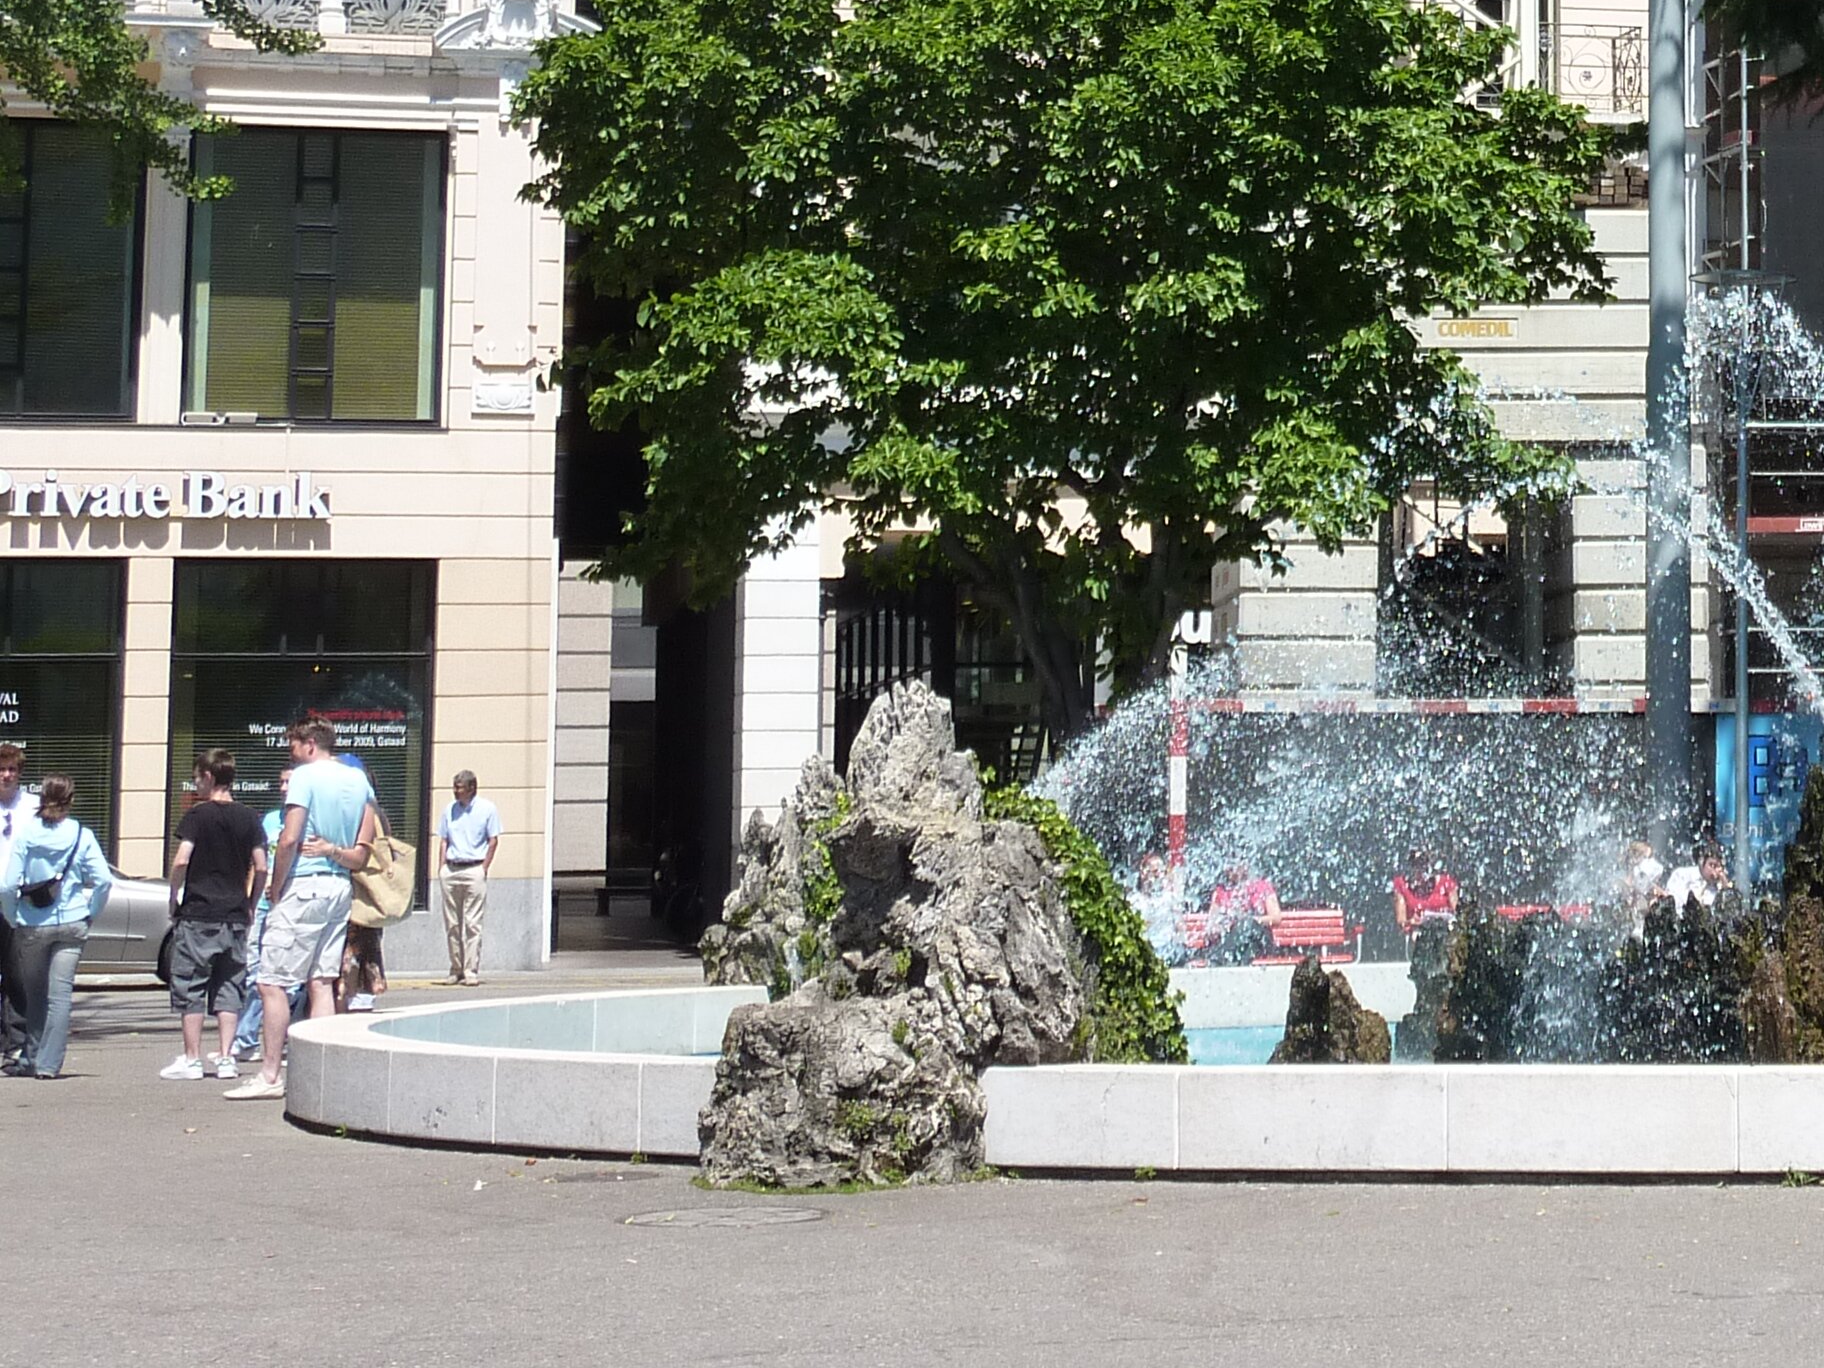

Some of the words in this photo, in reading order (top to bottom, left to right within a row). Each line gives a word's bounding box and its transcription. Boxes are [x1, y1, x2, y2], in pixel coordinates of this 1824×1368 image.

[181, 470, 332, 520] Bank
[248, 723, 263, 735] We
[264, 724, 287, 735] Conn
[360, 723, 370, 734] of
[369, 724, 407, 736] Harmony
[266, 737, 275, 747] 17
[377, 737, 406, 747] Gstaad
